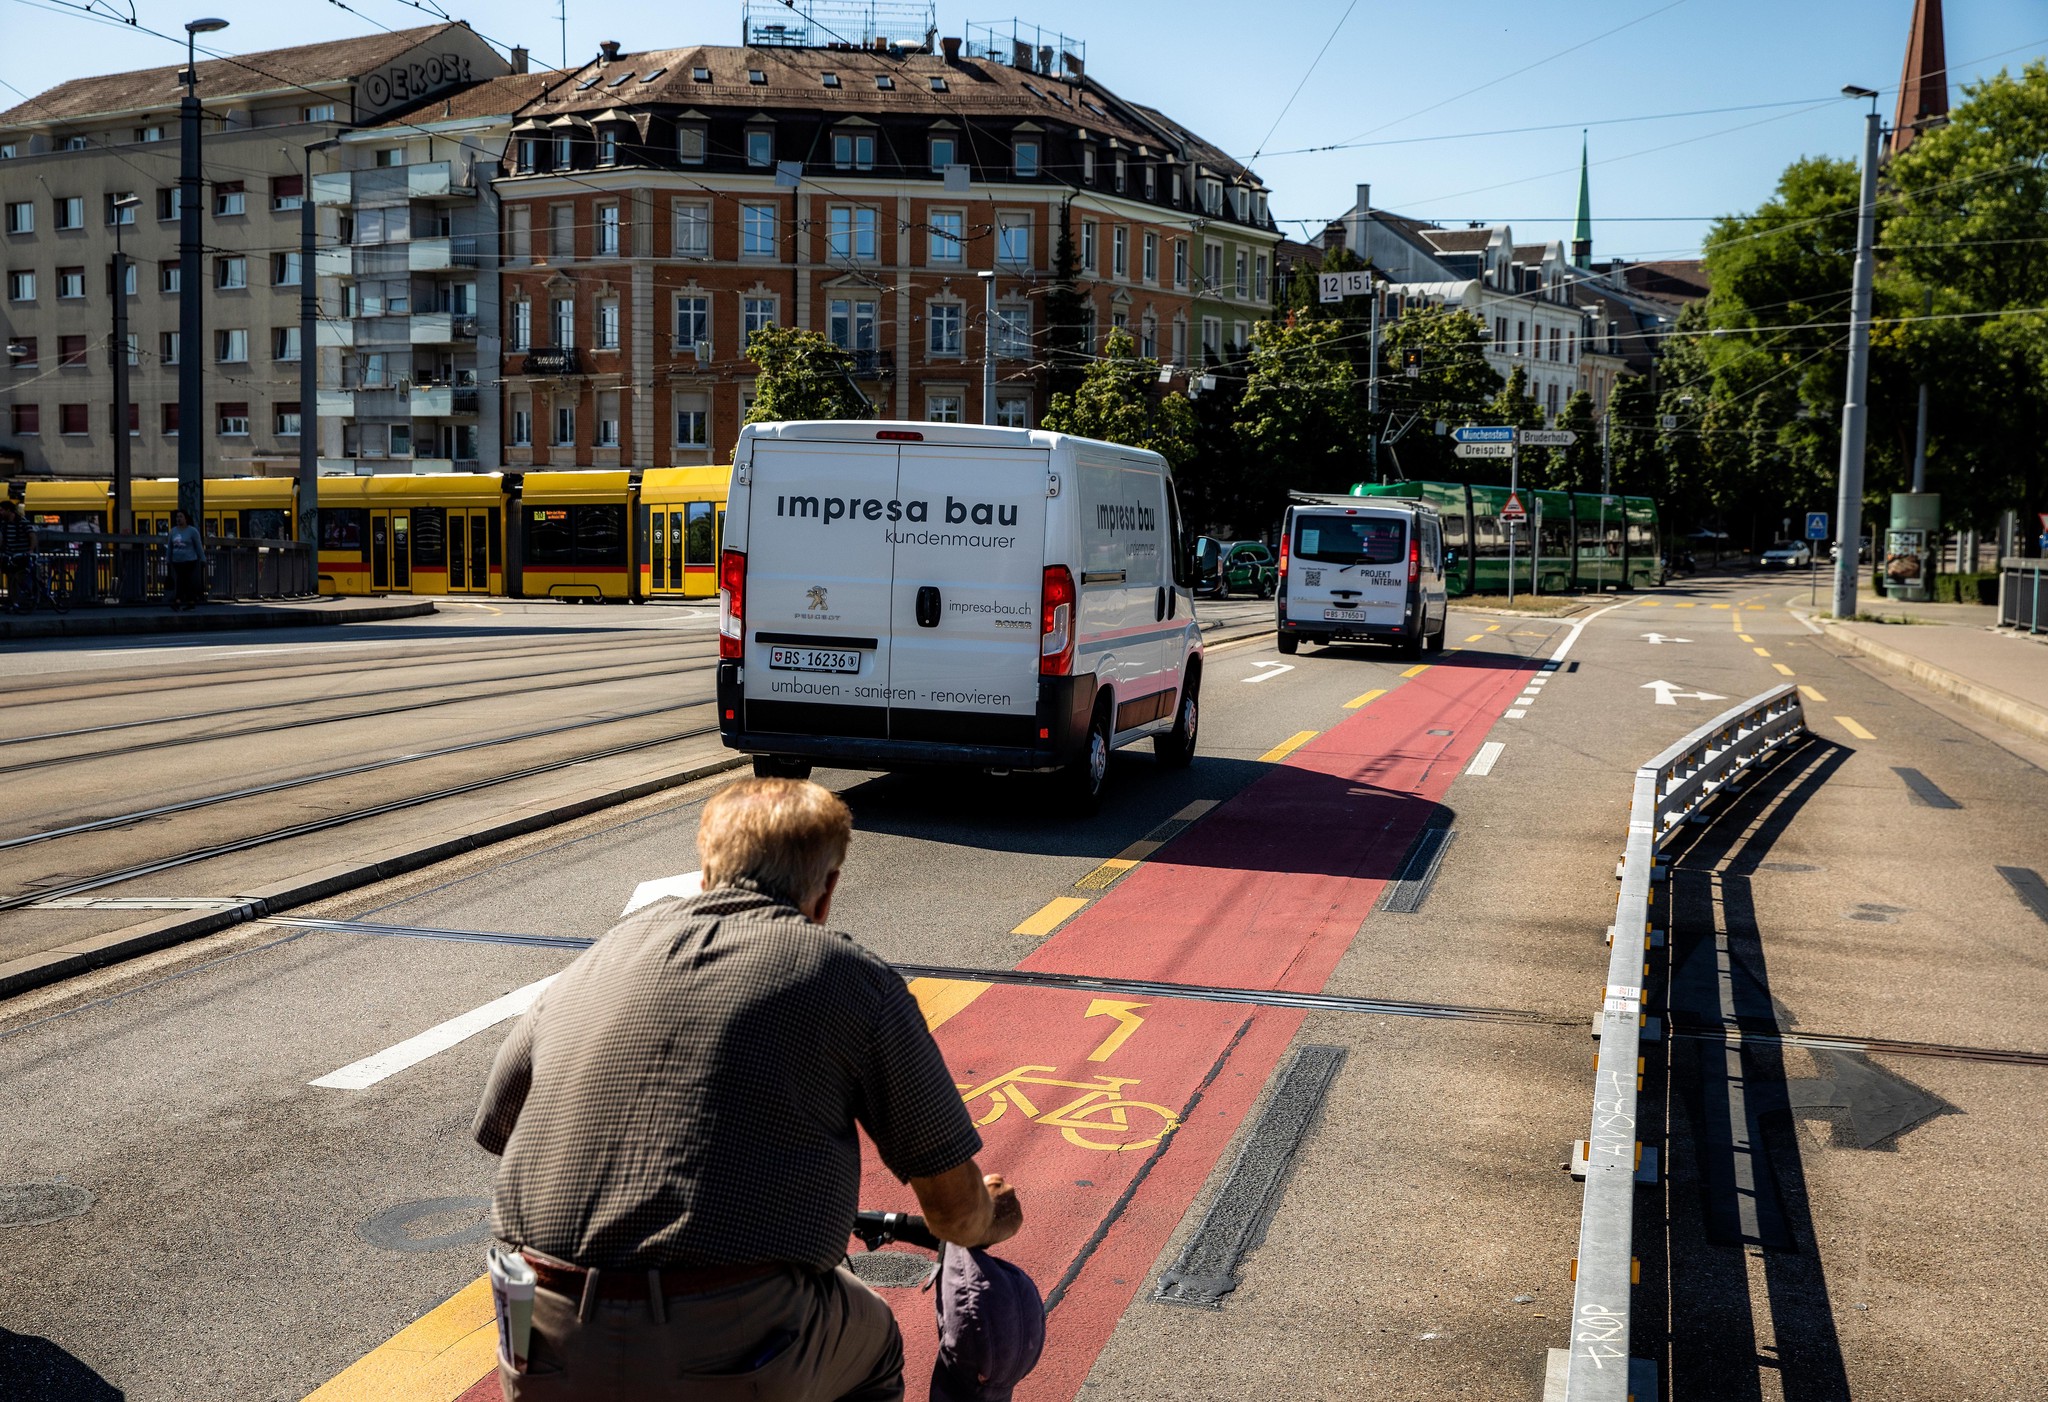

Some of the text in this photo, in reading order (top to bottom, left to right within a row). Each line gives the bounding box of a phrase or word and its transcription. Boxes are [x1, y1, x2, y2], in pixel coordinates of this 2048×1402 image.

[1322, 277, 1339, 293] 12
[1347, 275, 1362, 290] 15
[1462, 429, 1510, 440] Münchenstein
[1524, 431, 1569, 443] Bruderholz
[1465, 444, 1506, 457] Dreispitz
[945, 495, 1018, 526] bau
[1096, 499, 1155, 537] impresa bau
[885, 529, 1016, 548] kundenmaurer
[1360, 569, 1392, 578] PROJEKT
[1371, 578, 1402, 587] INTERIM
[949, 600, 1032, 615] impresa-bau.ch
[794, 613, 842, 621] PEUGEOT
[995, 620, 1032, 630] BOXER
[771, 676, 840, 696] umbauen
[854, 684, 916, 700] sanieren
[931, 689, 1011, 706] renovieren
